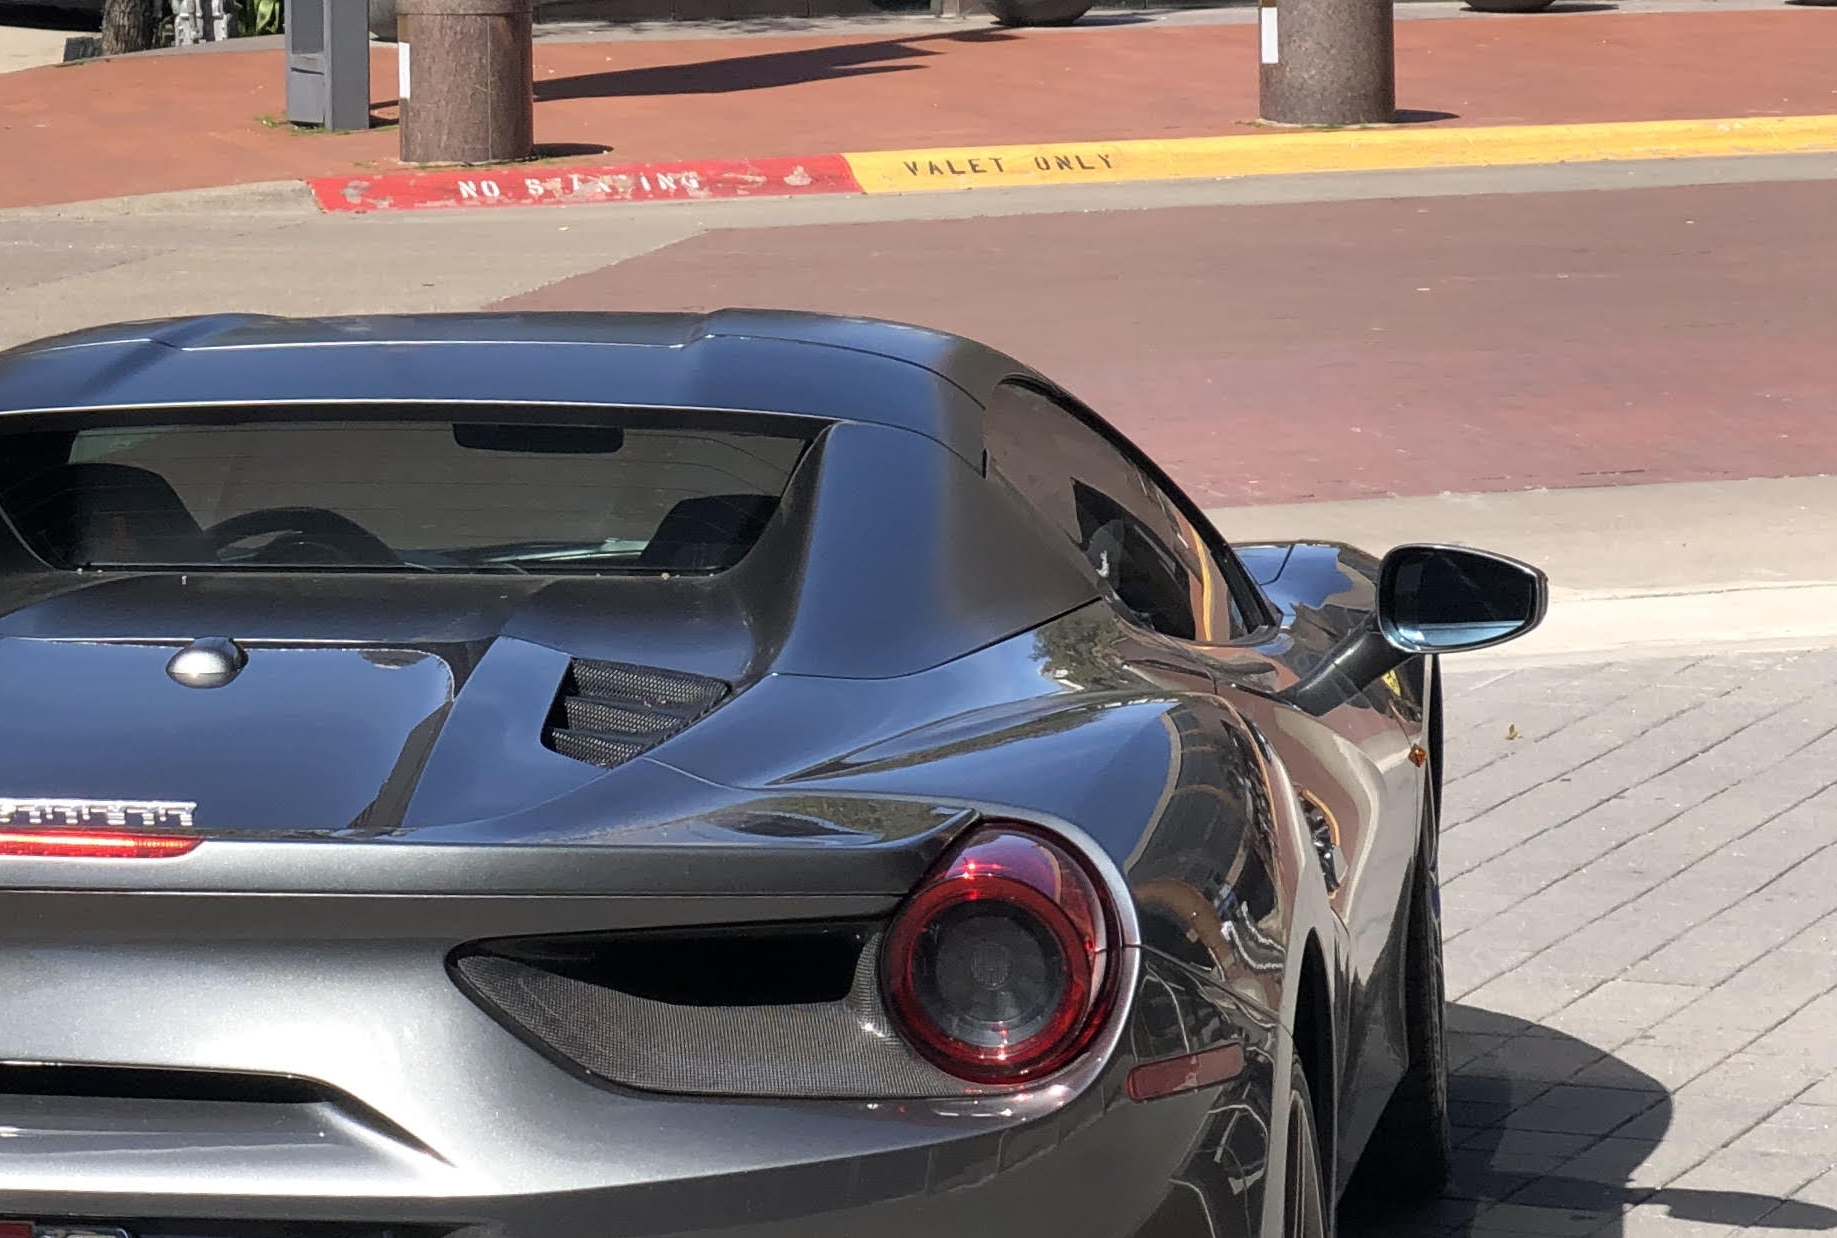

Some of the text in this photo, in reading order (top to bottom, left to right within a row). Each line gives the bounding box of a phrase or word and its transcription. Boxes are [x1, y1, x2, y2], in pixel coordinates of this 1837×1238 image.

[903, 153, 1114, 177] VALET ONLY
[457, 179, 501, 199] NO
